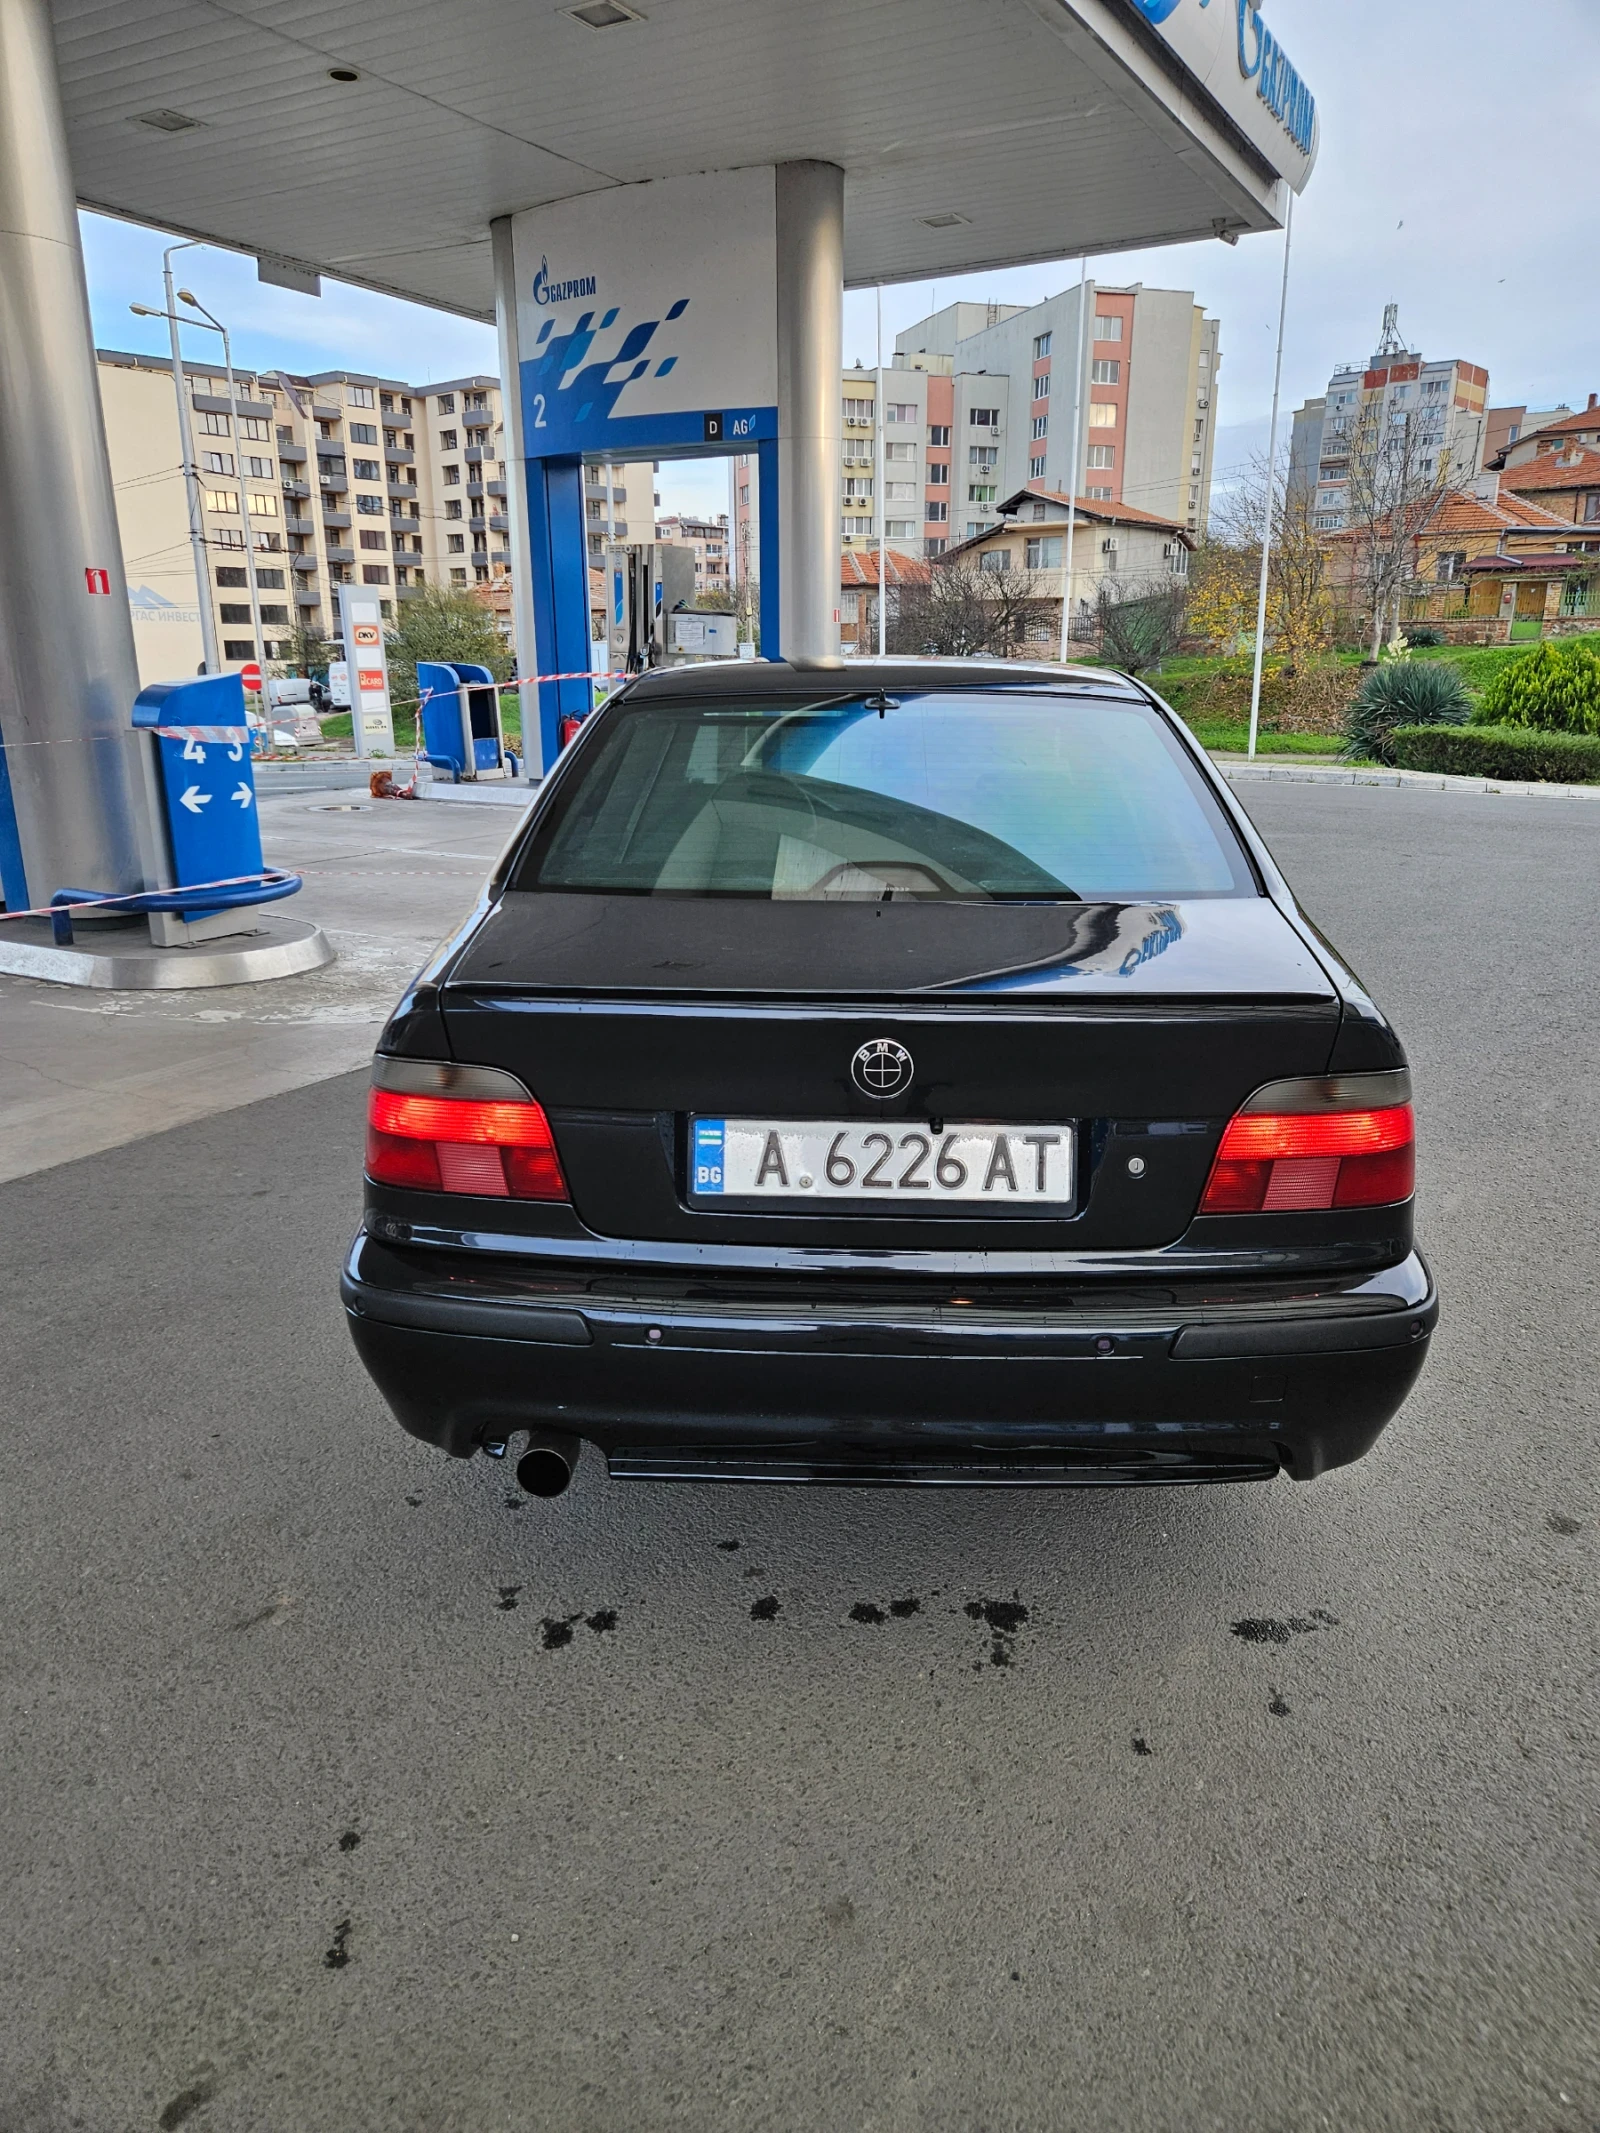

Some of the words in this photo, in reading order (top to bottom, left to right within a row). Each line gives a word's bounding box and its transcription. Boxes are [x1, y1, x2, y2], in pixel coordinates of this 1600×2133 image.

[550, 275, 597, 303] GAZPROM
[533, 393, 547, 428] 2
[709, 420, 718, 435] D
[732, 419, 749, 435] AG
[358, 631, 375, 639] DKV
[183, 730, 207, 764] 4
[226, 728, 243, 762] 3
[858, 1042, 909, 1062] BMW
[754, 1129, 790, 1187] A
[824, 1130, 969, 1190] 6226
[982, 1133, 1061, 1192] AT
[697, 1166, 722, 1184] BG
